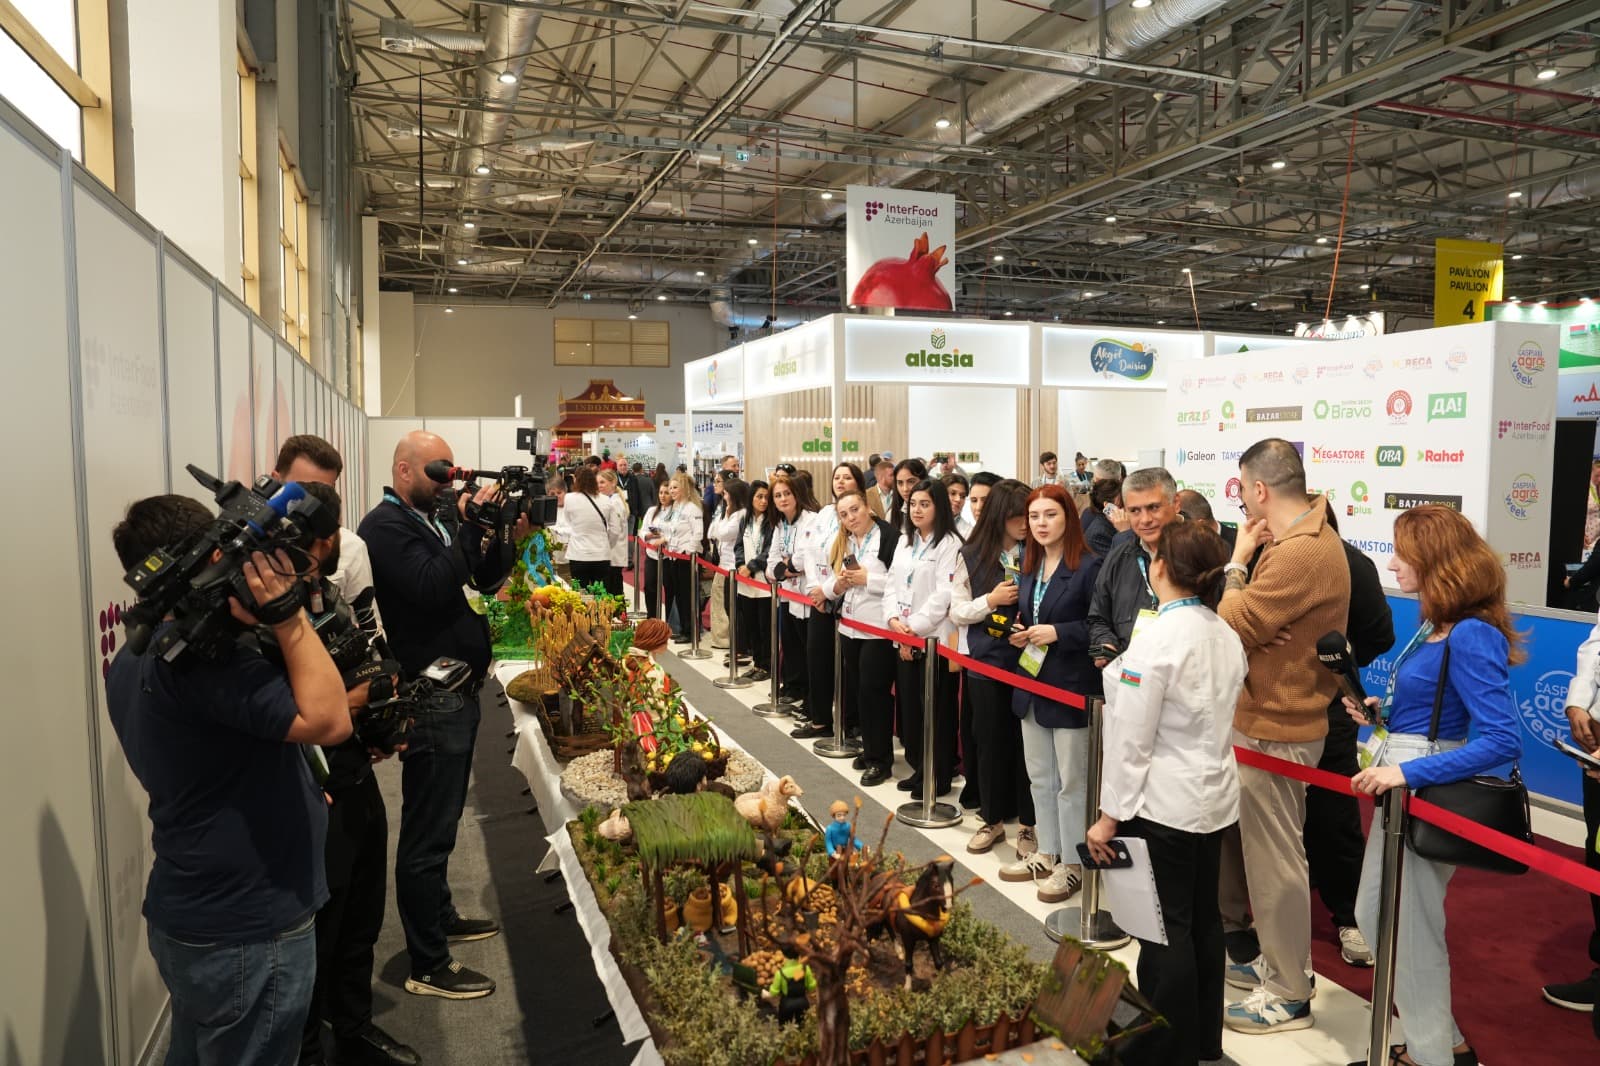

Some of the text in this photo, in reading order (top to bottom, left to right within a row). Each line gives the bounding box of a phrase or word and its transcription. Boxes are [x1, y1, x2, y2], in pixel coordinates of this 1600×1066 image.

[886, 203, 938, 217] InterFood
[884, 214, 933, 228] Azerbaijan
[1449, 265, 1490, 278] PAVİLYON
[1450, 281, 1488, 292] PAVILION
[1462, 300, 1475, 320] 4
[905, 348, 974, 368] alasia
[773, 359, 797, 376] alasia
[575, 404, 637, 413] INDONESIA
[1331, 404, 1372, 418] Bravo
[1431, 397, 1462, 416] ДА!
[1513, 421, 1551, 432] InterFood
[802, 437, 859, 453] alaia
[1187, 450, 1216, 461] Galeon
[1312, 446, 1365, 460] MEGASTORE
[1379, 449, 1402, 462] OBA
[1425, 449, 1465, 463] Rahat
[1347, 538, 1394, 554] TAMSTOR
[355, 665, 381, 678] SONY
[1535, 681, 1568, 696] CASP
[1520, 699, 1568, 743] week
